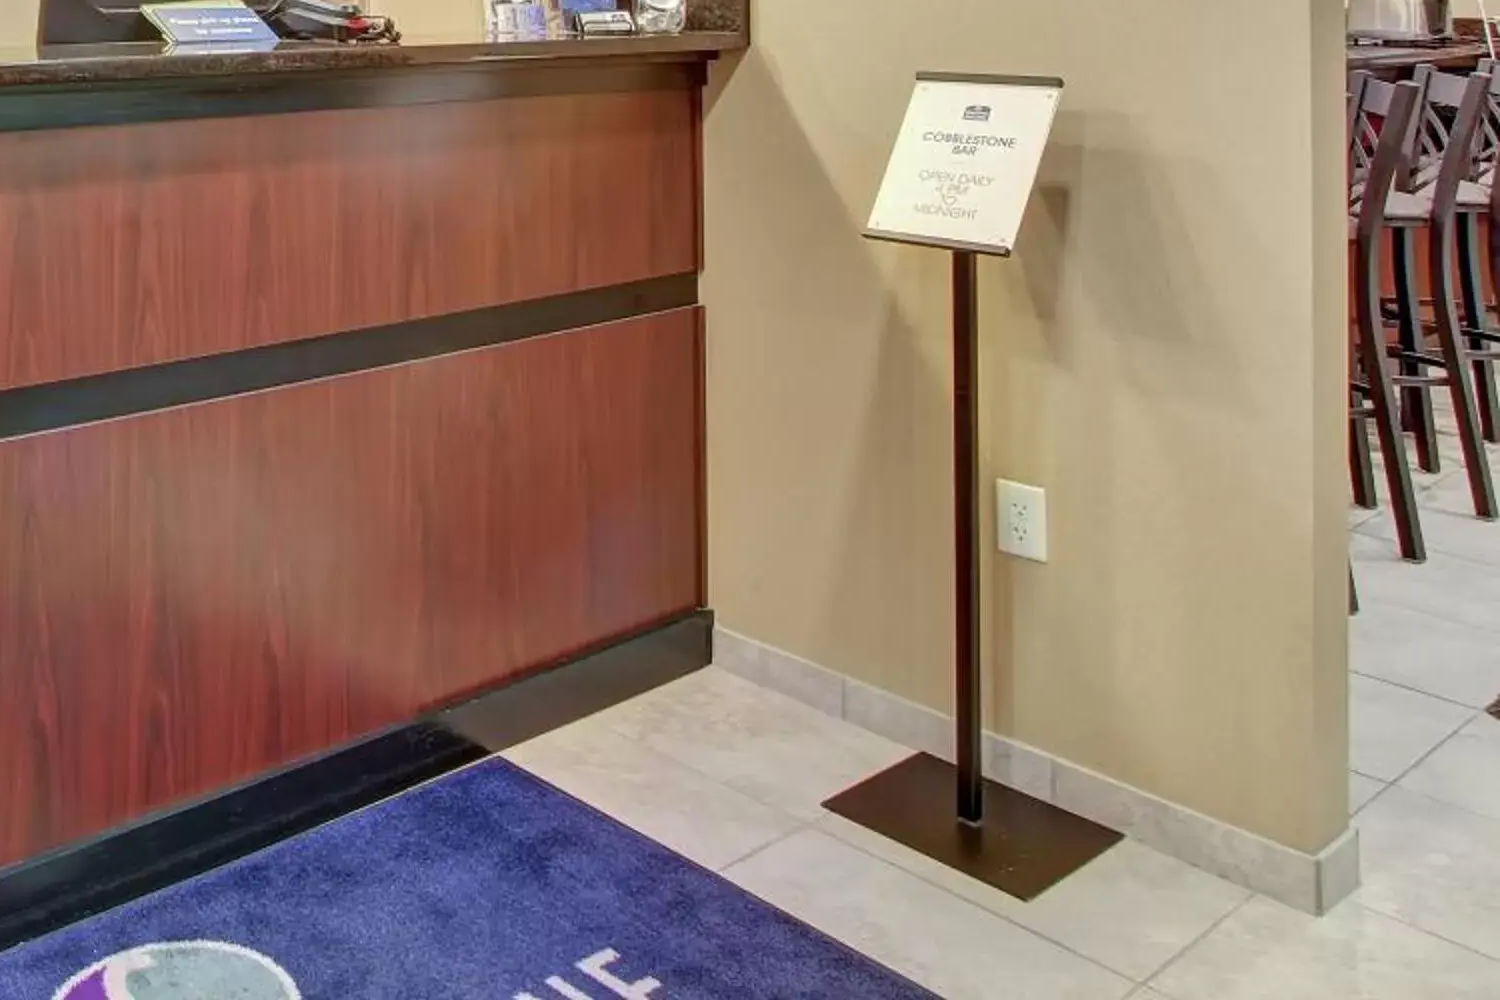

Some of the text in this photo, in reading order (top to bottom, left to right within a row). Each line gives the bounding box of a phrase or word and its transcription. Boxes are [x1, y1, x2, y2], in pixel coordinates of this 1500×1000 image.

[922, 130, 1019, 149] COBBLESTONE
[951, 144, 979, 156] BAR
[918, 169, 995, 187] OPEN DAILY
